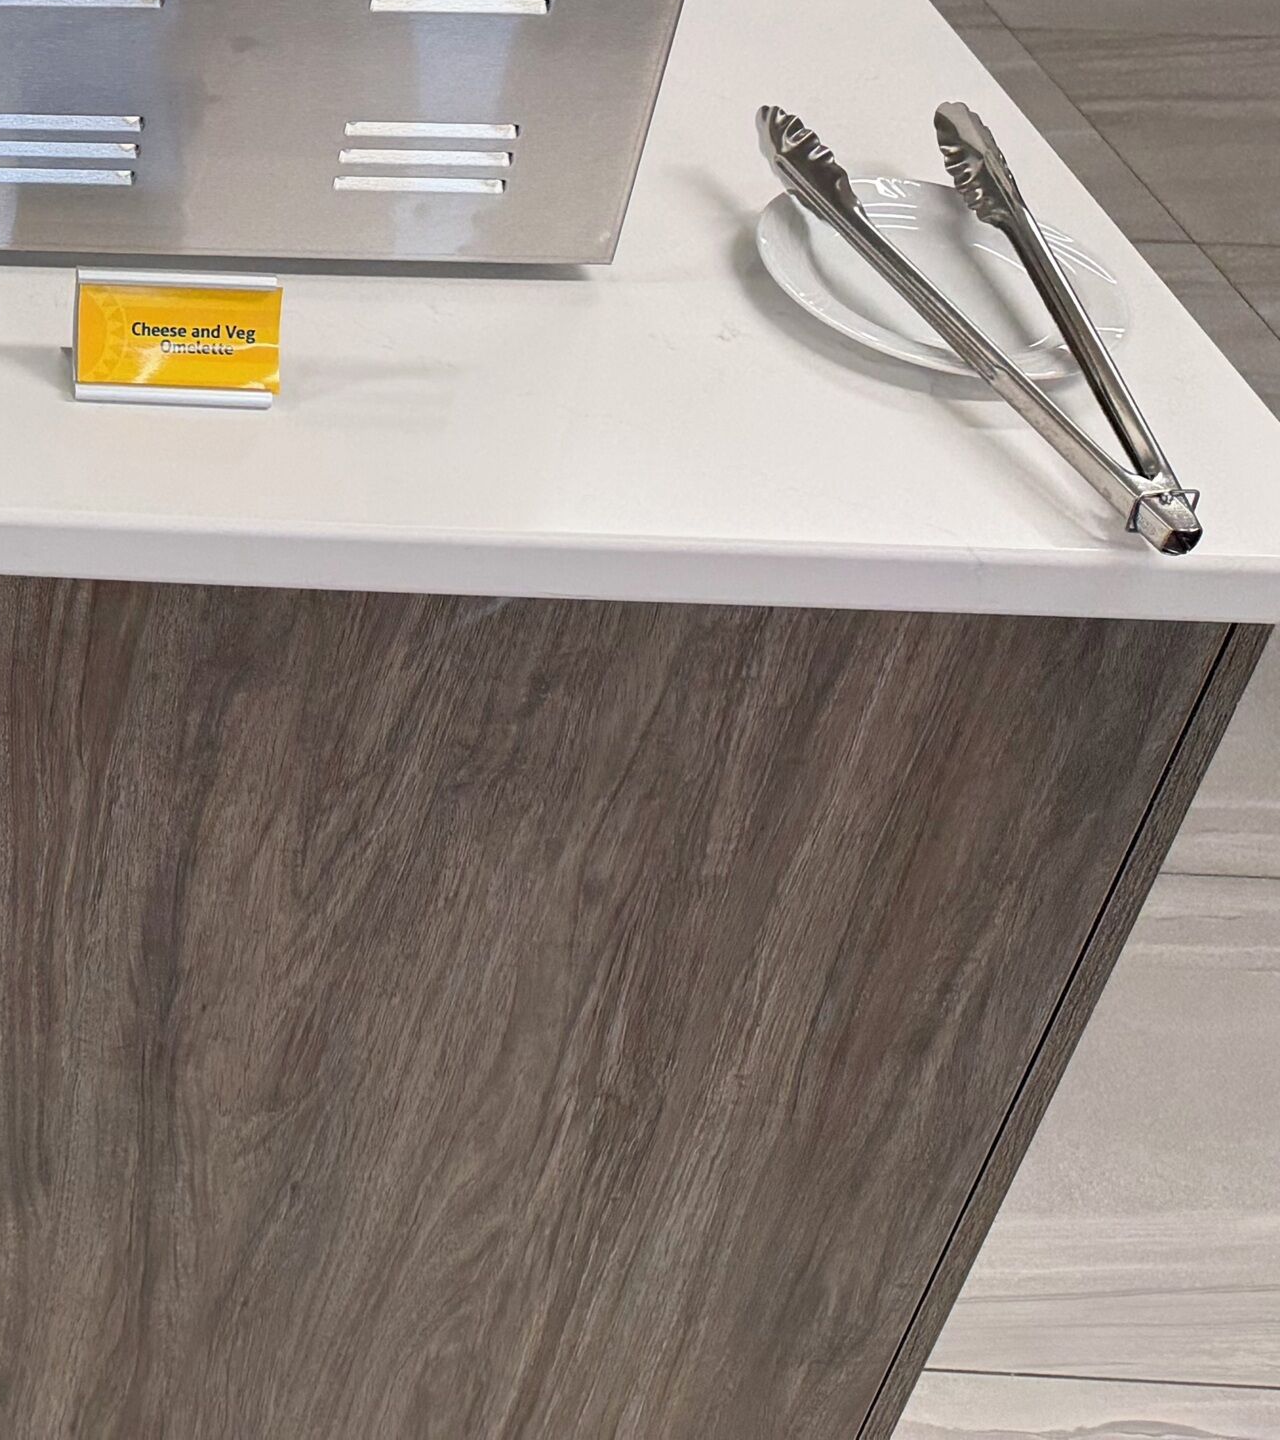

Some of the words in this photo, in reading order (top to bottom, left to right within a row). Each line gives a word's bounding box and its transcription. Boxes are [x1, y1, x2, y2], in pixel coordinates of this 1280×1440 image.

[131, 321, 187, 338] Cheese
[191, 324, 221, 339] and
[225, 325, 256, 344] Veg
[160, 339, 234, 356] Omelette
